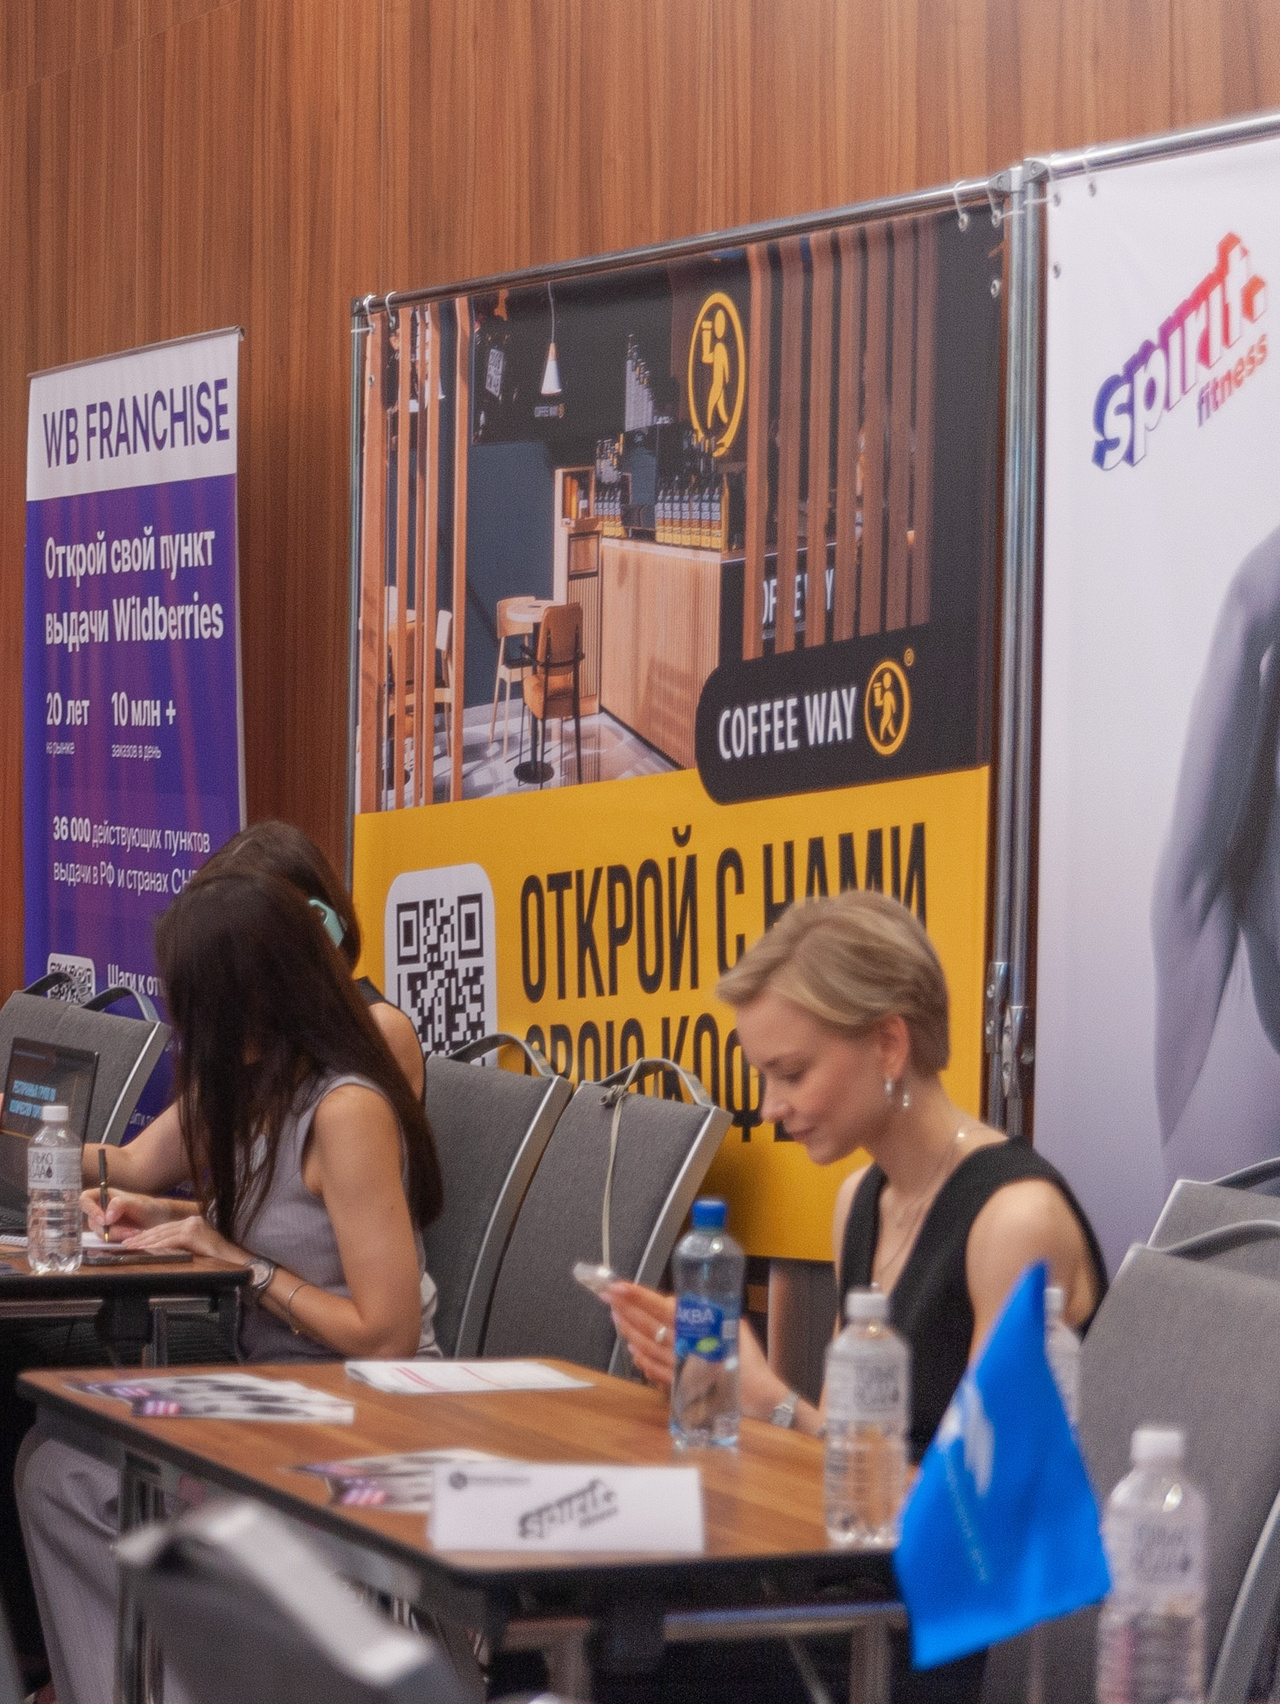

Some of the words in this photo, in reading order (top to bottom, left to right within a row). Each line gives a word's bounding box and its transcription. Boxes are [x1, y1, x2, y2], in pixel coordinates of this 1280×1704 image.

[1196, 333, 1268, 428] fitness
[42, 406, 79, 469] WB
[85, 377, 231, 462] FRANCHISE
[45, 530, 108, 588] Открой
[110, 525, 156, 574] свой
[160, 530, 216, 581] пункт
[45, 605, 109, 653] выдачи
[112, 590, 224, 643] Wildberries
[46, 691, 62, 726] 20
[66, 699, 91, 726] лет
[111, 691, 129, 727] 10
[131, 699, 161, 727] млн
[719, 697, 798, 760] COFFEE
[803, 686, 857, 746] WAY
[53, 816, 68, 841] 36
[70, 816, 91, 843] 000
[91, 820, 162, 853] действующих
[164, 829, 211, 857] пунктов
[53, 861, 91, 887] выдачи
[92, 866, 99, 885] в
[100, 861, 115, 888] РФ
[117, 867, 125, 888] и
[126, 869, 169, 896] странах
[171, 867, 198, 895] СН
[521, 824, 699, 1004] ОТКРОЙ
[715, 847, 746, 980] С
[107, 963, 137, 990] Шаги
[138, 973, 146, 994] к
[146, 975, 160, 997] от
[662, 1012, 795, 1143] КОФ
